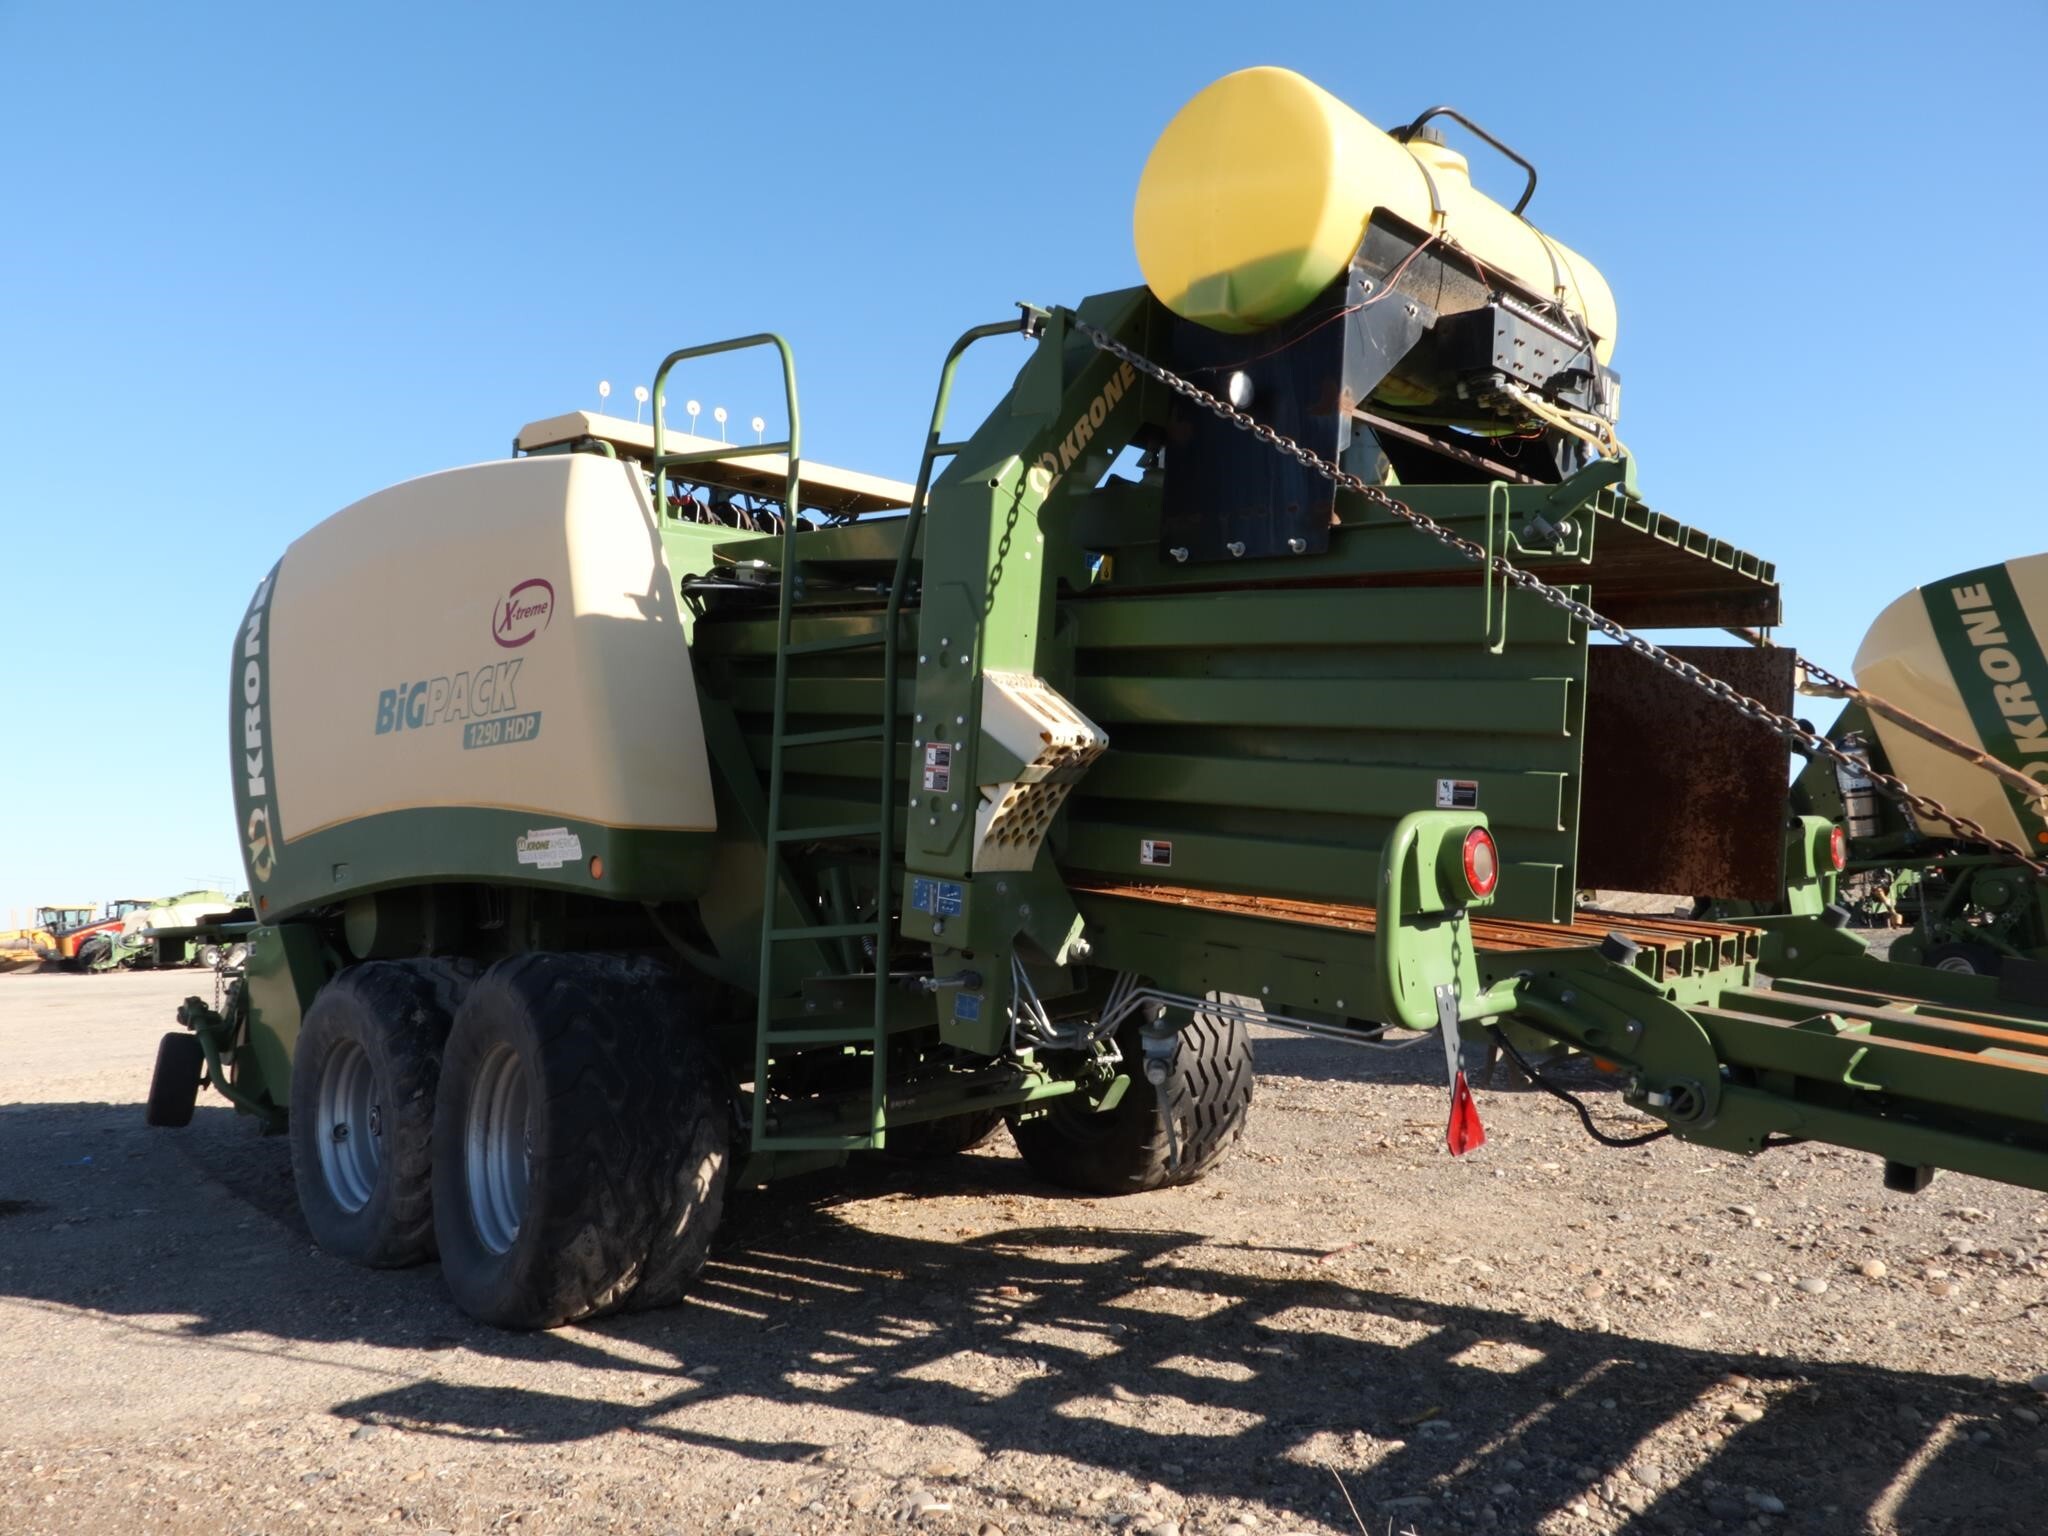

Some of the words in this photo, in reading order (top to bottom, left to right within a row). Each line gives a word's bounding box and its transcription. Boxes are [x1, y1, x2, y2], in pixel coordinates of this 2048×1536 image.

[1058, 360, 1136, 472] KRONE
[498, 599, 549, 634] X-treme
[1951, 582, 2048, 754] KRONE
[469, 720, 501, 748] 1290
[504, 715, 536, 742] HDP
